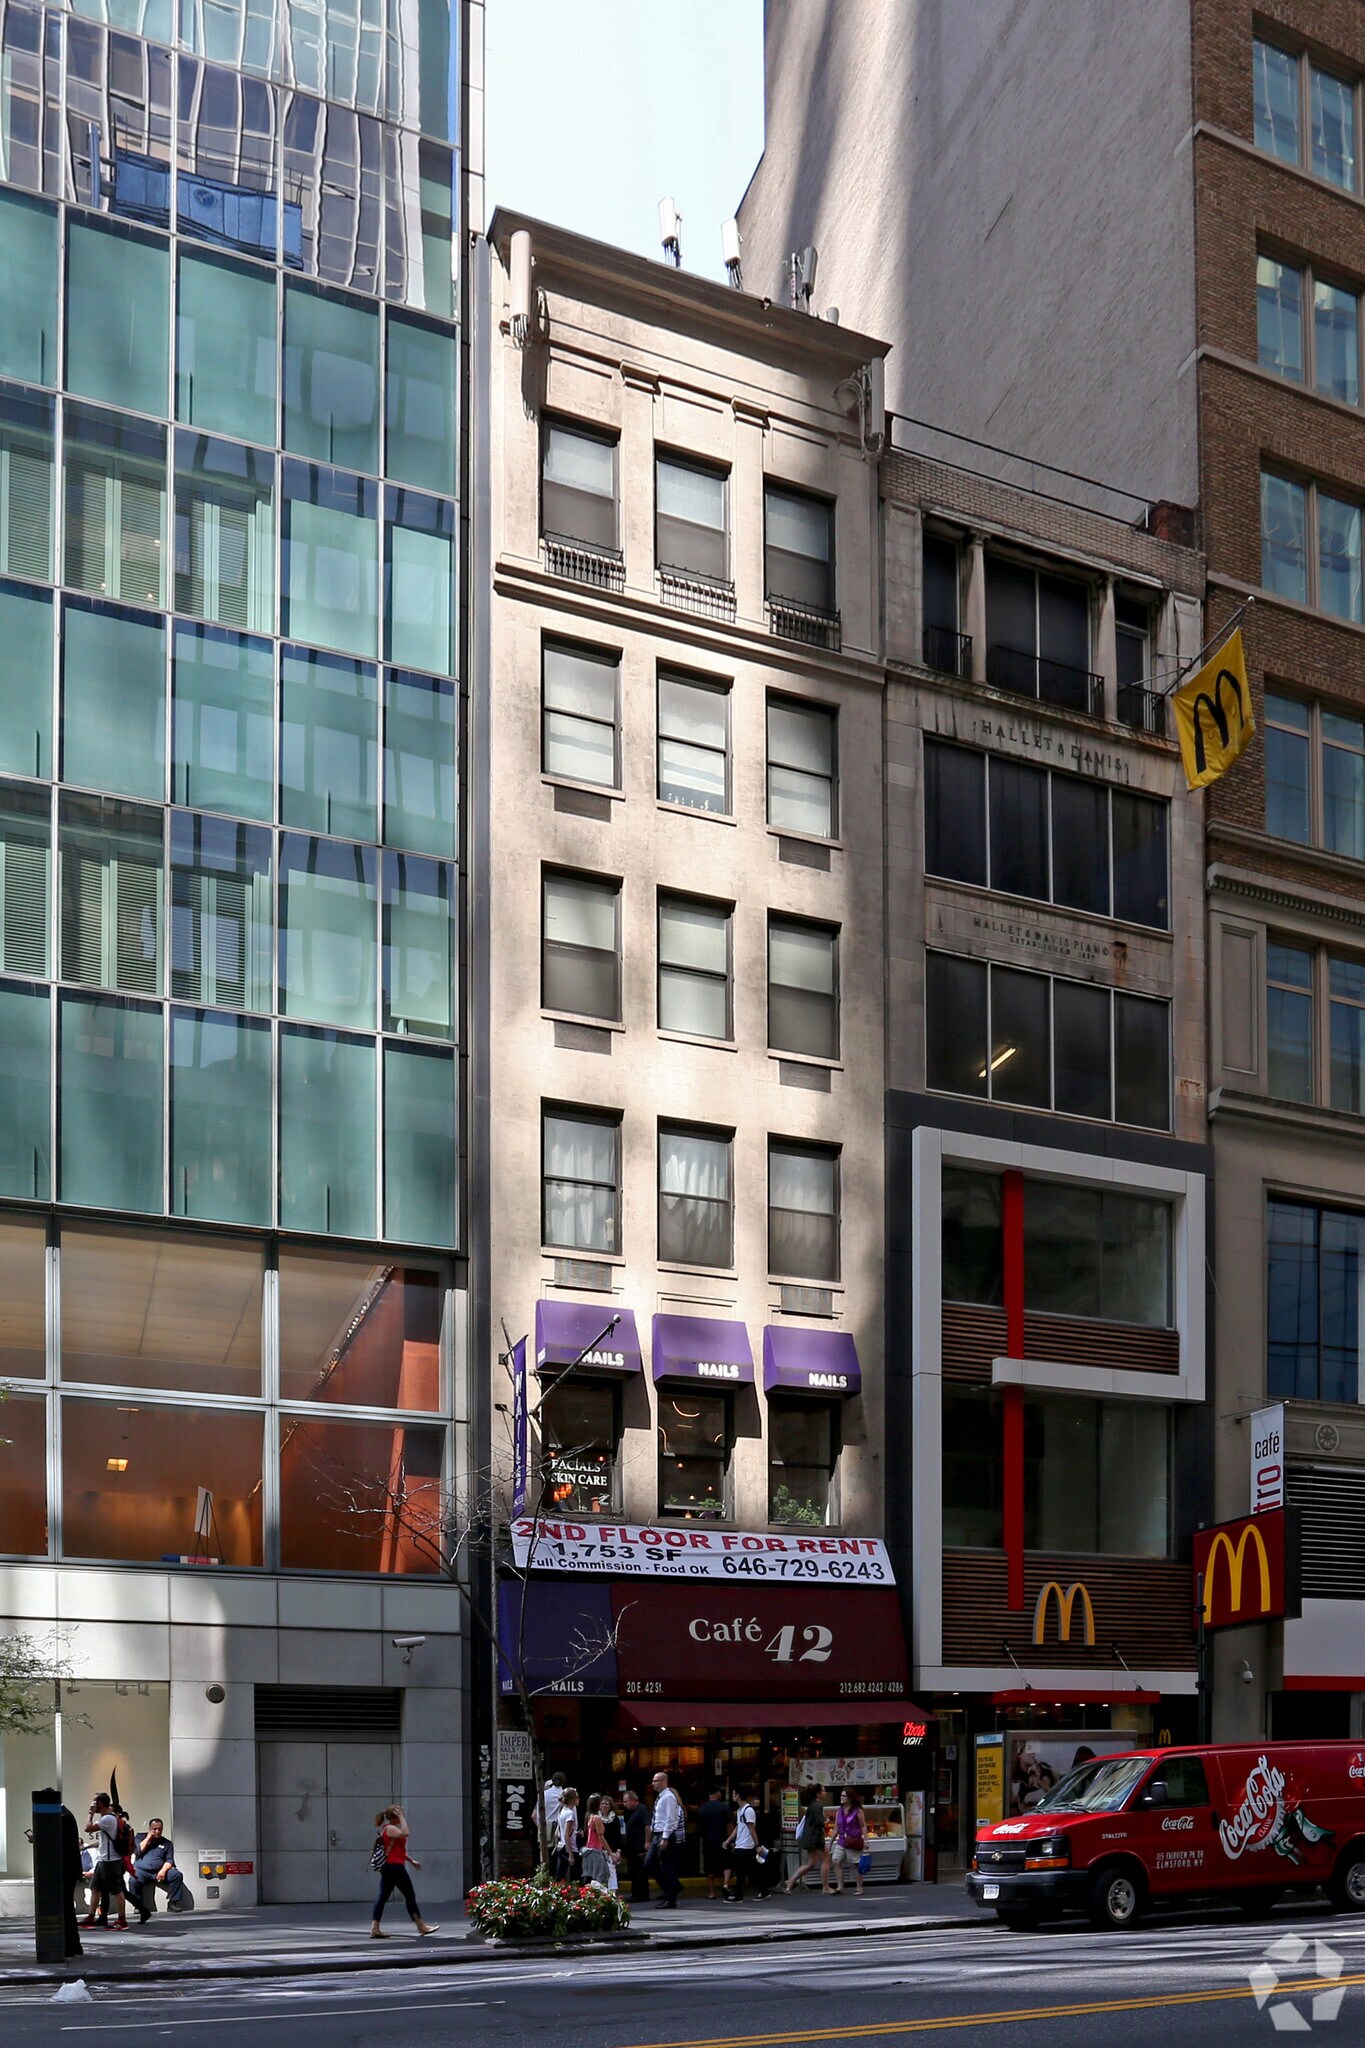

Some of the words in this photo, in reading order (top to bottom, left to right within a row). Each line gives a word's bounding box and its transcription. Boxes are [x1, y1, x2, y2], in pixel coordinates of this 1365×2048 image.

[981, 719, 1052, 751] HALLET
[1070, 744, 1122, 771] DAVIS
[581, 1350, 625, 1367] NAILS
[698, 1362, 740, 1378] NAILS
[808, 1373, 848, 1388] NAILS
[1254, 1431, 1280, 1460] café
[551, 1458, 601, 1473] FACIALS
[551, 1472, 577, 1484] SKIN
[578, 1474, 608, 1486] CARE
[515, 1521, 587, 1541] 2ND
[599, 1527, 712, 1550] FLOOR
[721, 1536, 788, 1552] FOR
[796, 1539, 878, 1556] RENT
[552, 1542, 635, 1560] 1,753
[645, 1547, 682, 1562] SF
[530, 1557, 554, 1568] Full
[558, 1558, 642, 1572] Commission
[653, 1564, 686, 1574] Food
[689, 1565, 710, 1575] OK
[722, 1555, 885, 1580] 646-729-6243
[688, 1617, 763, 1642] Café
[764, 1625, 833, 1662] 42
[551, 1681, 585, 1692] NAILS
[626, 1681, 636, 1693] 20
[644, 1682, 654, 1693] 42
[654, 1682, 664, 1693] St.
[505, 1784, 526, 1830] NAILS
[1193, 1858, 1204, 1868] NY
